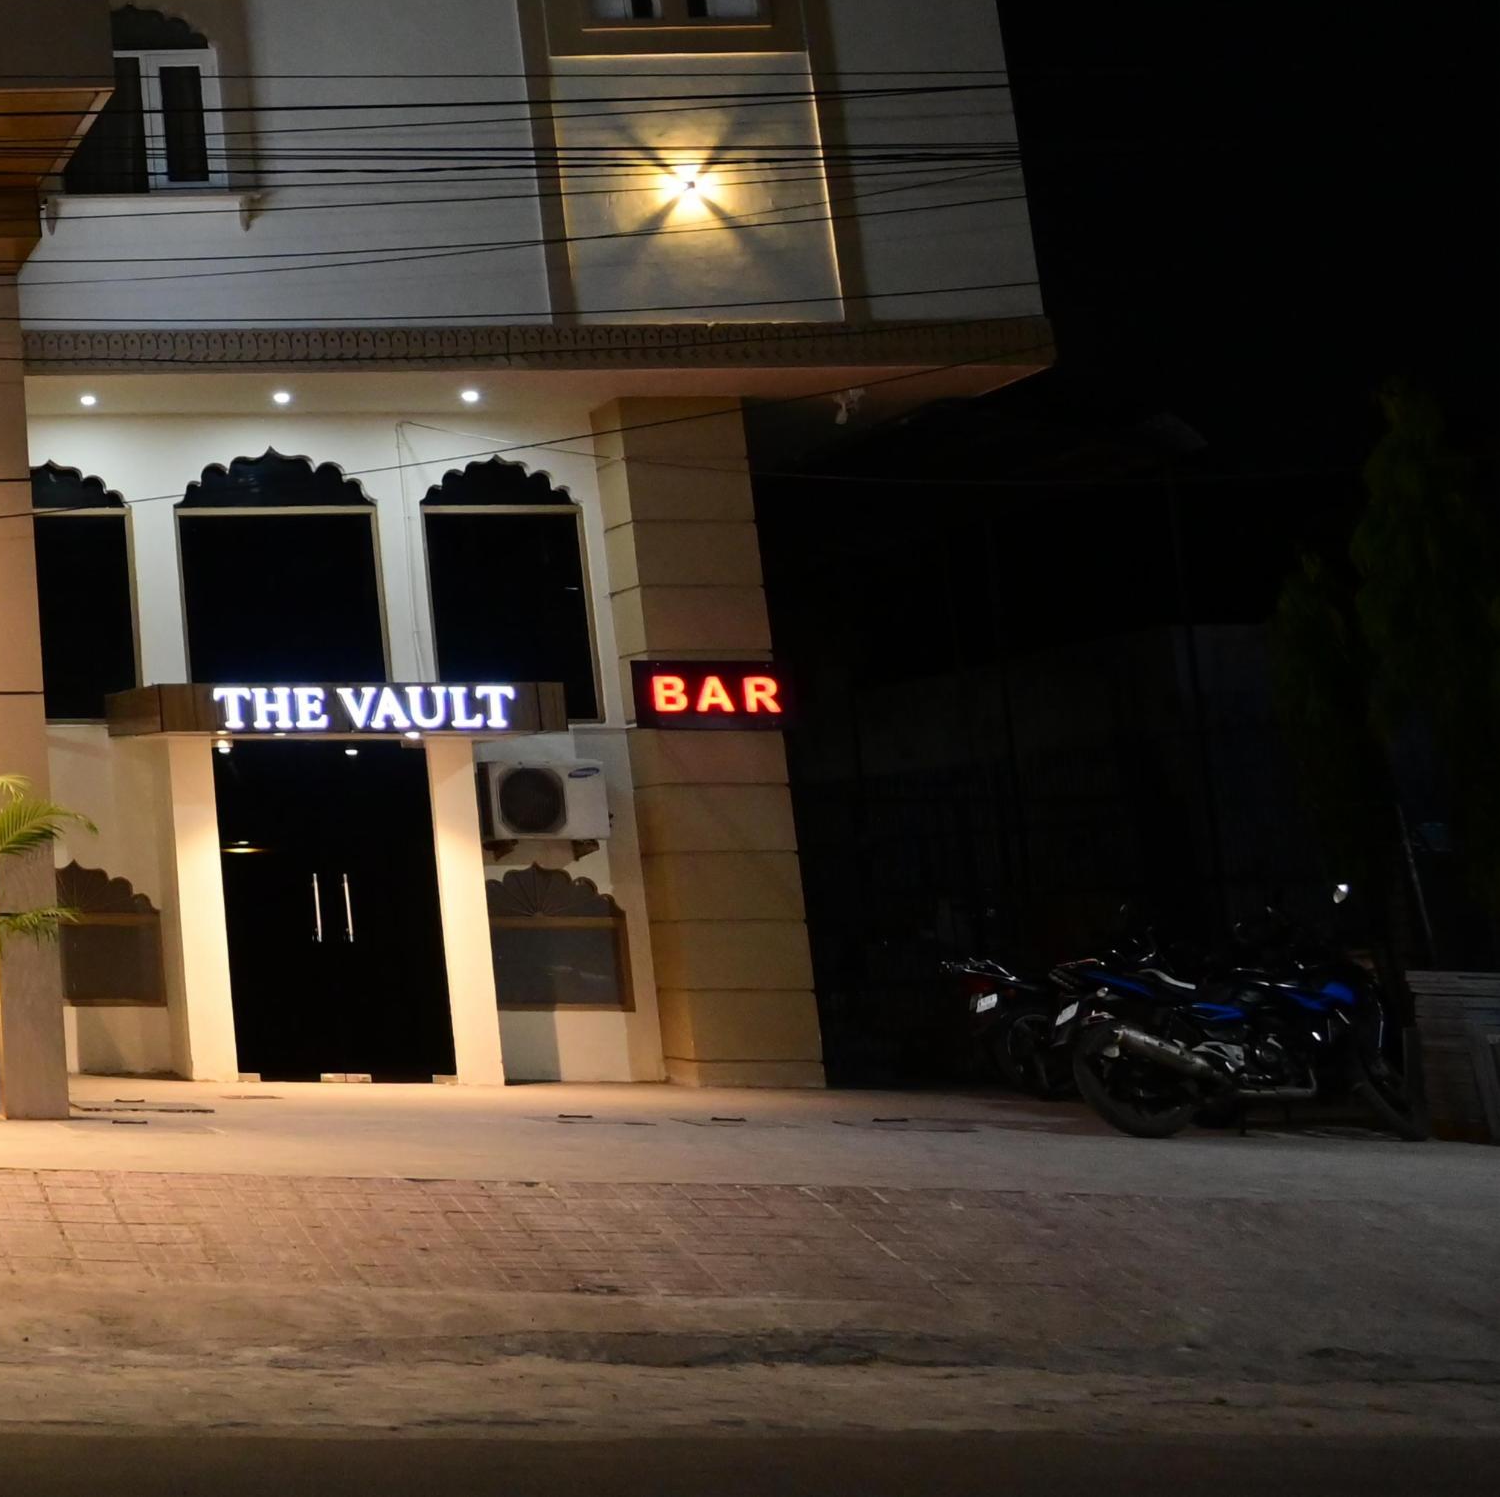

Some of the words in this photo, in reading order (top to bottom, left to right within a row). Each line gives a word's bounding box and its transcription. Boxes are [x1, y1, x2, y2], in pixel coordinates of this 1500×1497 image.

[212, 686, 329, 730] THE
[335, 685, 516, 730] VAULT
[651, 675, 782, 714] BAR
